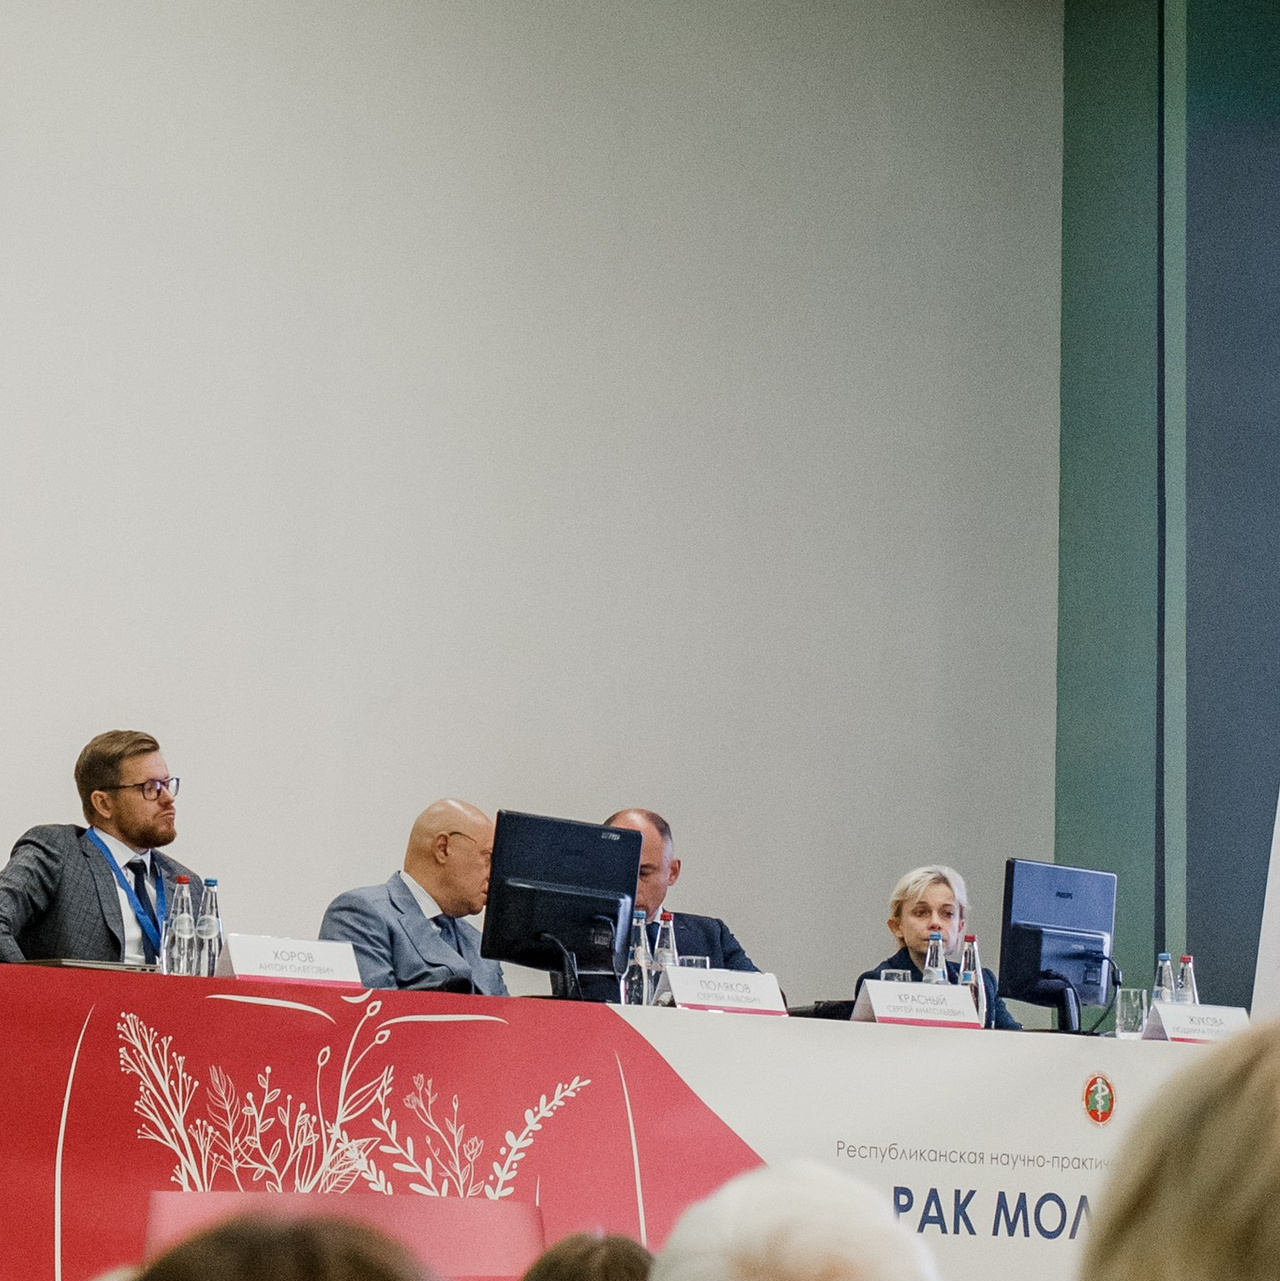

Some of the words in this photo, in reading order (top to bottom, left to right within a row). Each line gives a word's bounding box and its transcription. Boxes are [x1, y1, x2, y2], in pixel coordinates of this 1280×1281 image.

[272, 950, 315, 963] ХОРОВ
[699, 980, 751, 994] ПОЛЯКОВ
[897, 993, 948, 1007] КРАСНЫЙ
[835, 1140, 985, 1165] Республиканская
[893, 1186, 977, 1236] РАК
